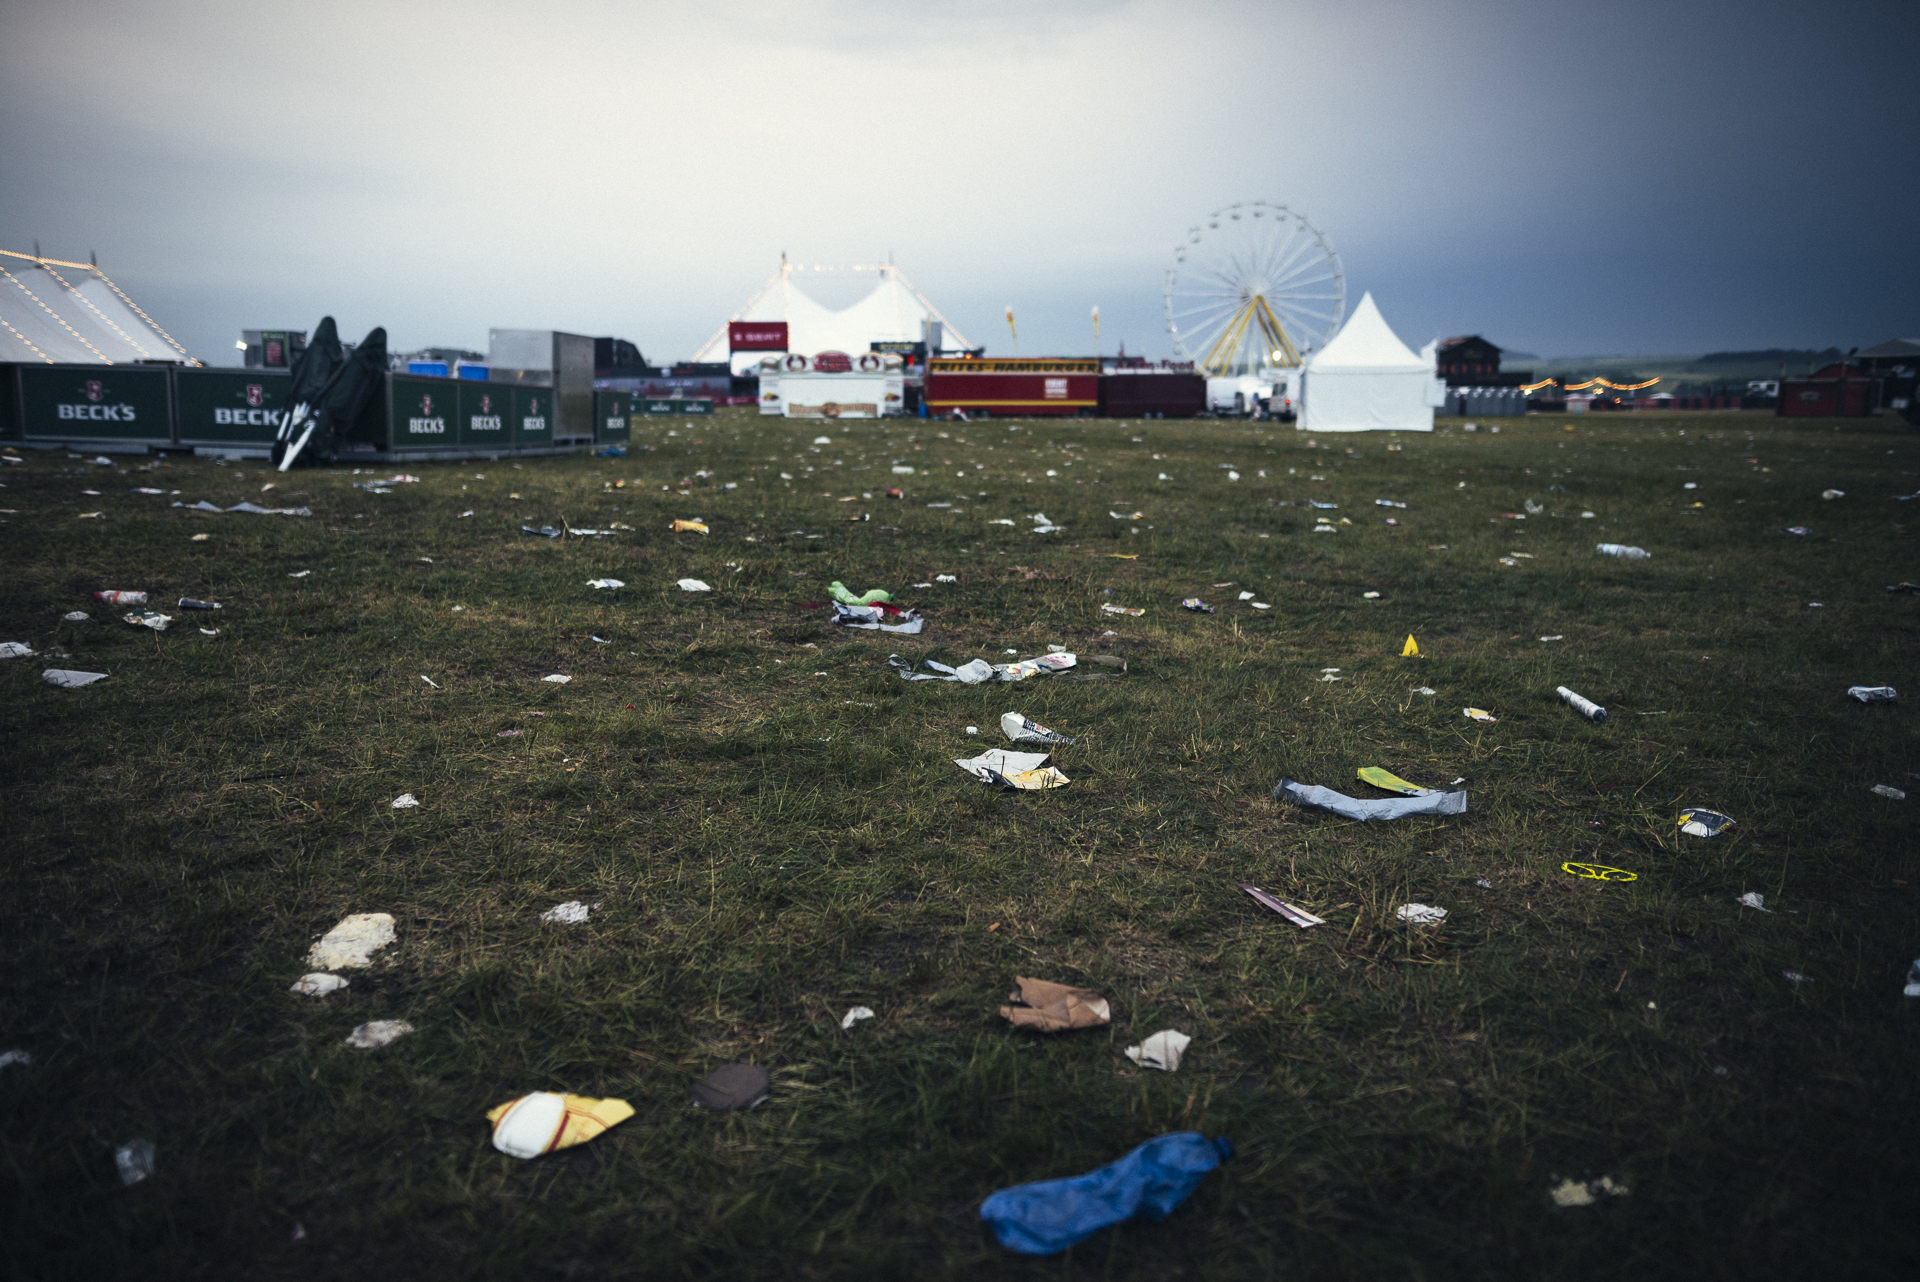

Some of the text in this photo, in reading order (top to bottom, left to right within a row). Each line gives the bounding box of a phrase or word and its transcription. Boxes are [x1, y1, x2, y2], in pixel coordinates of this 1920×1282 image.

[58, 402, 136, 421] BECK'S
[409, 415, 445, 434] BECK'S
[471, 413, 501, 431] BECK'S
